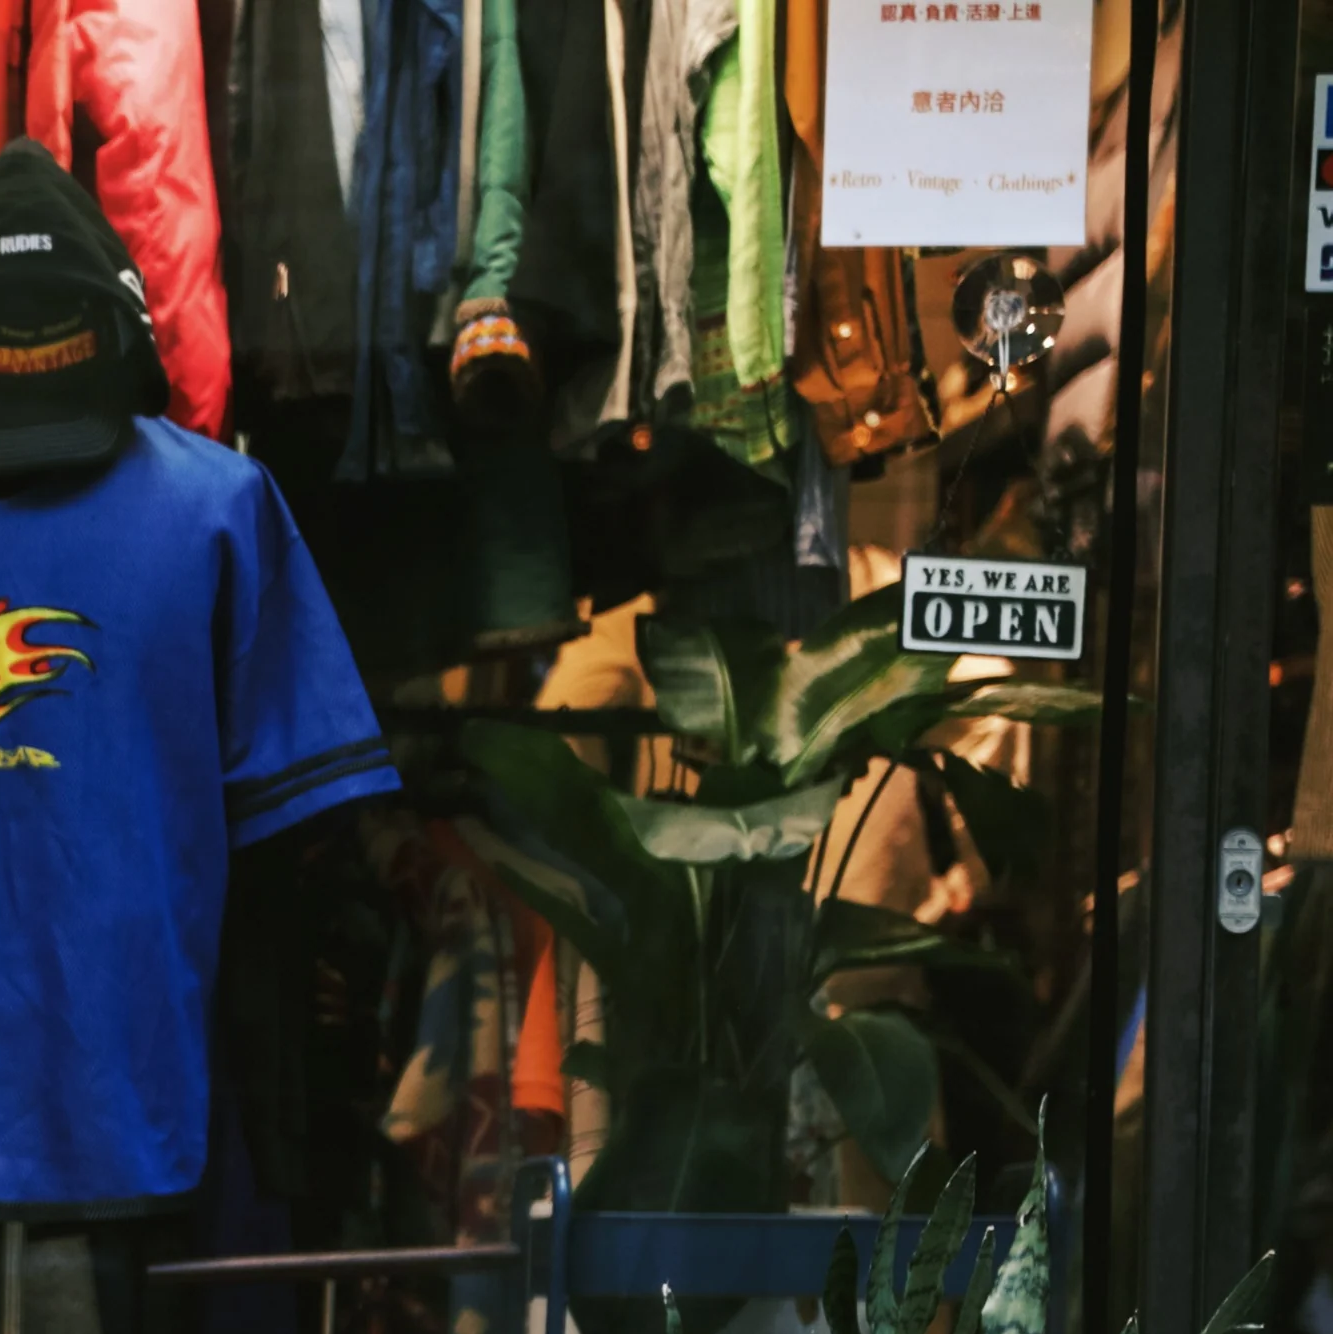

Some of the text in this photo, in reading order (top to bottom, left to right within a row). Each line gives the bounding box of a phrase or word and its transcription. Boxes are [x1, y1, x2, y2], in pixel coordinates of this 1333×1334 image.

[907, 169, 963, 196] Vintage
[922, 567, 1071, 594] YES, WE ARE
[924, 597, 1062, 644] OPEN
